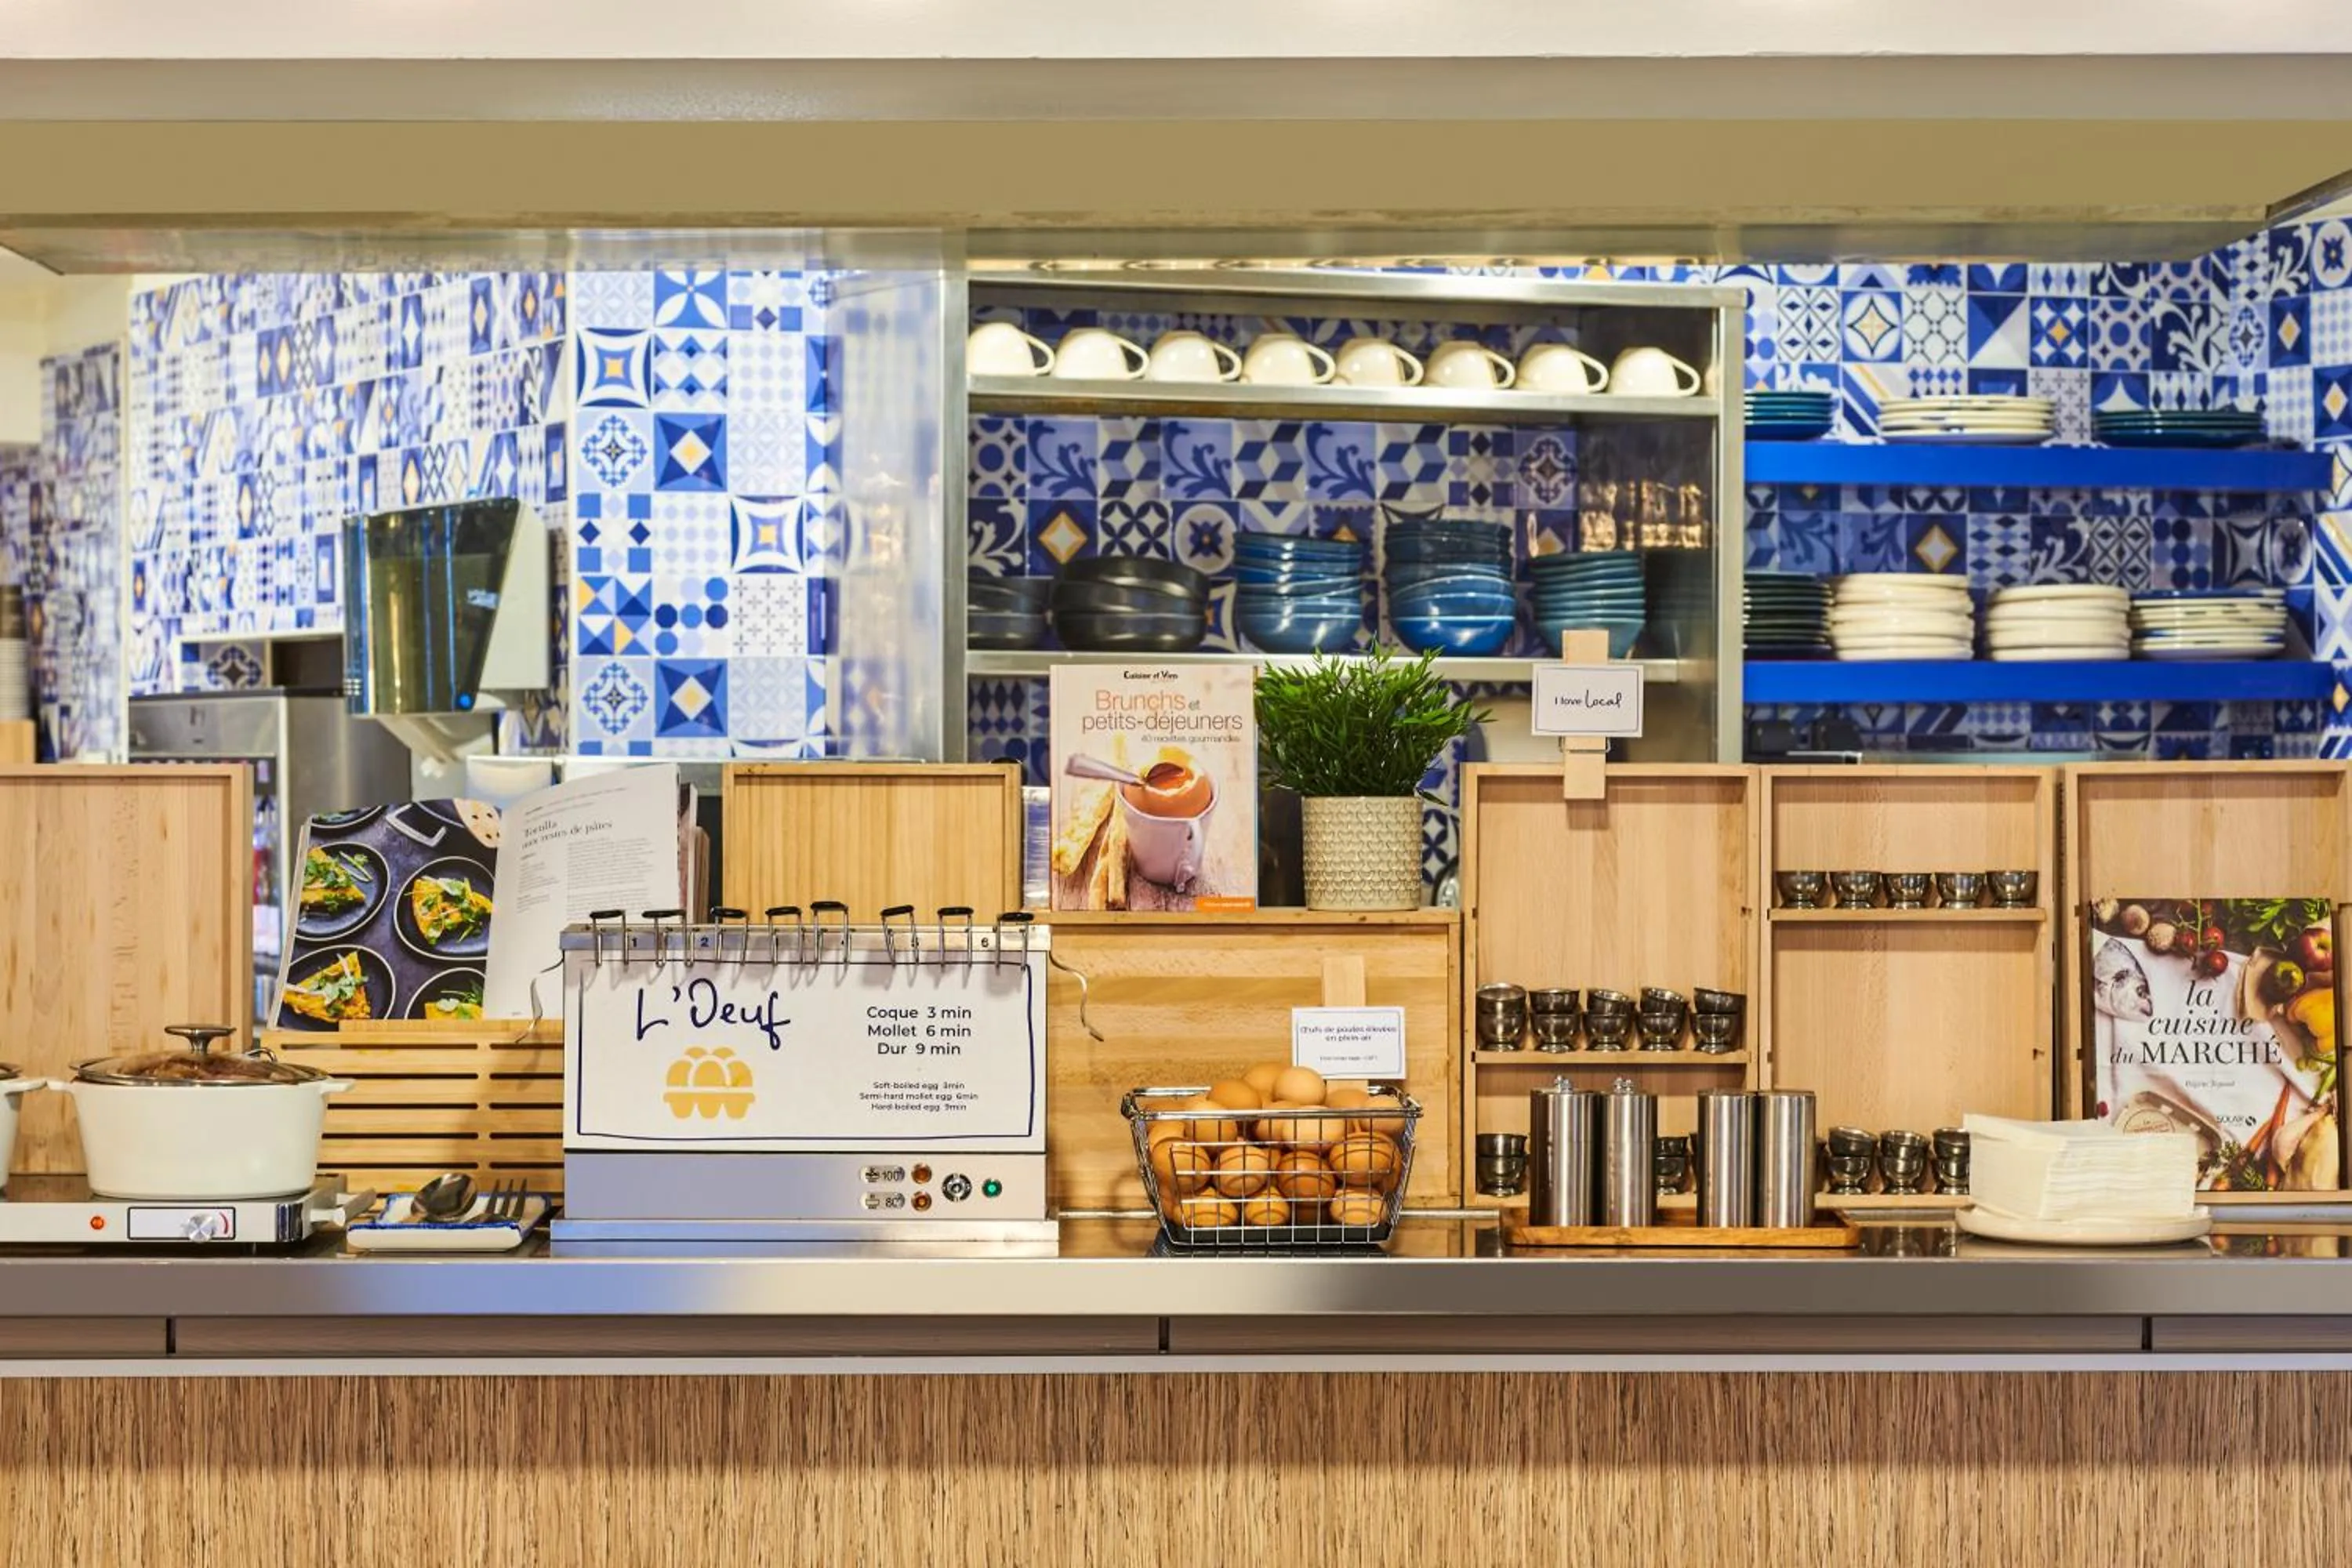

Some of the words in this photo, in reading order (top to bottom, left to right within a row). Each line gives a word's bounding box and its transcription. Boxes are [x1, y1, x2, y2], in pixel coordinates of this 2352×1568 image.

[1095, 689, 1186, 711] Brunchs
[1189, 699, 1200, 710] et
[1082, 711, 1243, 734] petits-déjeuners
[524, 819, 557, 838] Tortilla
[632, 938, 637, 947] 1
[700, 937, 710, 947] 2
[981, 938, 989, 947] 6
[2186, 980, 2215, 1007] la
[866, 1006, 919, 1021] Coque
[927, 1006, 936, 1018] 3
[942, 1006, 971, 1018] min
[868, 1024, 916, 1036] Mollet
[926, 1025, 935, 1036] 6
[941, 1024, 971, 1036] min
[2148, 1009, 2254, 1036] cuisine
[877, 1042, 907, 1054] Dur
[915, 1042, 925, 1054] 9
[931, 1042, 960, 1054] min
[2110, 1047, 2133, 1064] du
[2140, 1035, 2282, 1065] MARCHÉ
